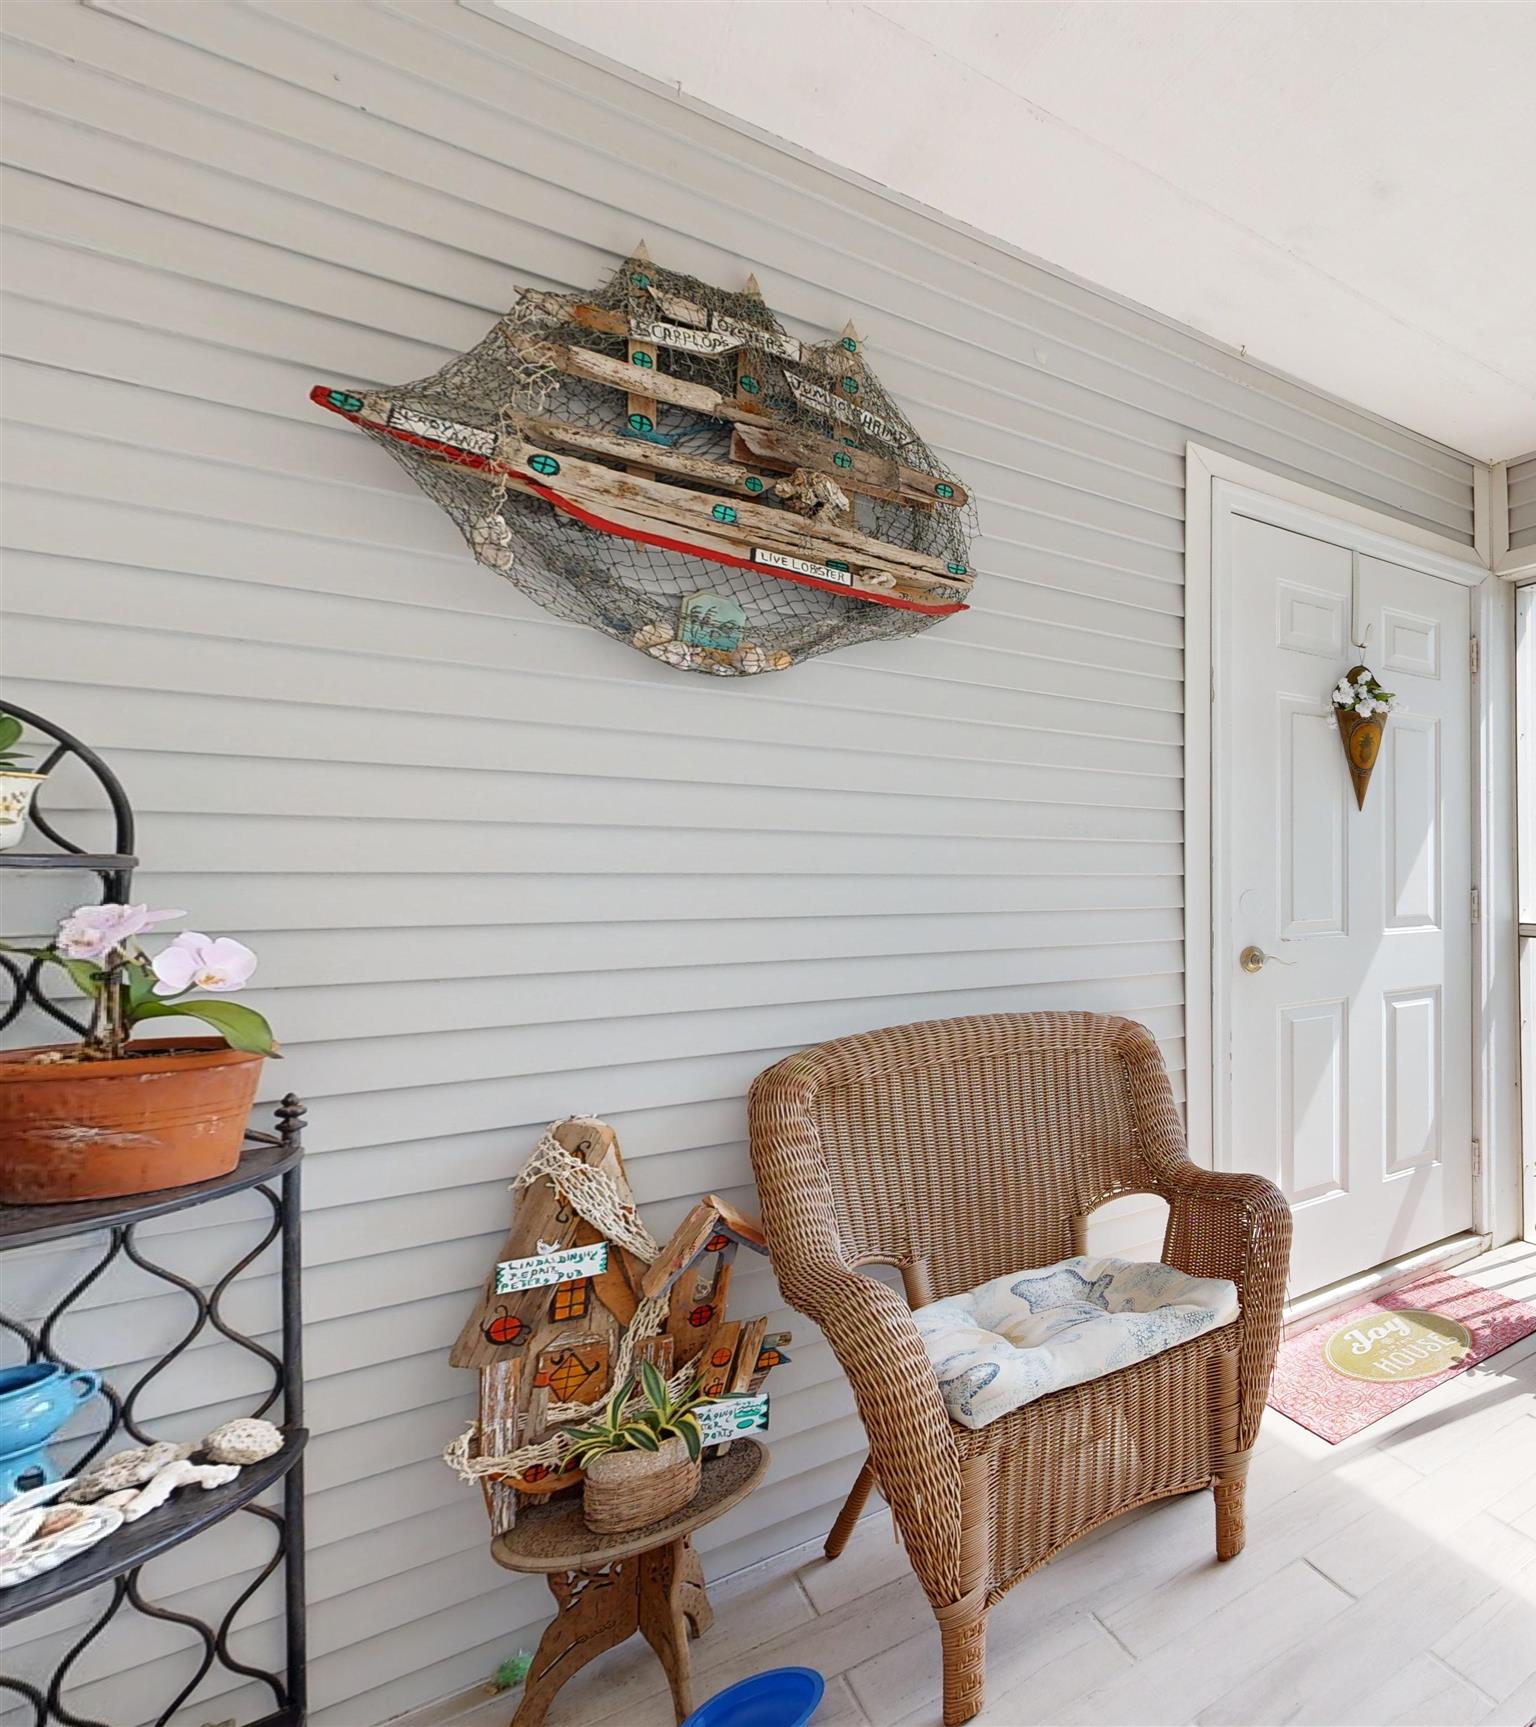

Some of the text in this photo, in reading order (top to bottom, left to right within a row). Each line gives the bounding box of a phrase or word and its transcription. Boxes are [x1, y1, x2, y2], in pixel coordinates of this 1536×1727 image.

[761, 551, 845, 582] LIVE LOBSTER
[509, 1266, 558, 1281] REPAIR
[556, 1269, 583, 1282] PUB
[1343, 1316, 1411, 1355] Joy
[1372, 1331, 1458, 1375] HOUSE
[703, 1428, 734, 1442] PORTS
